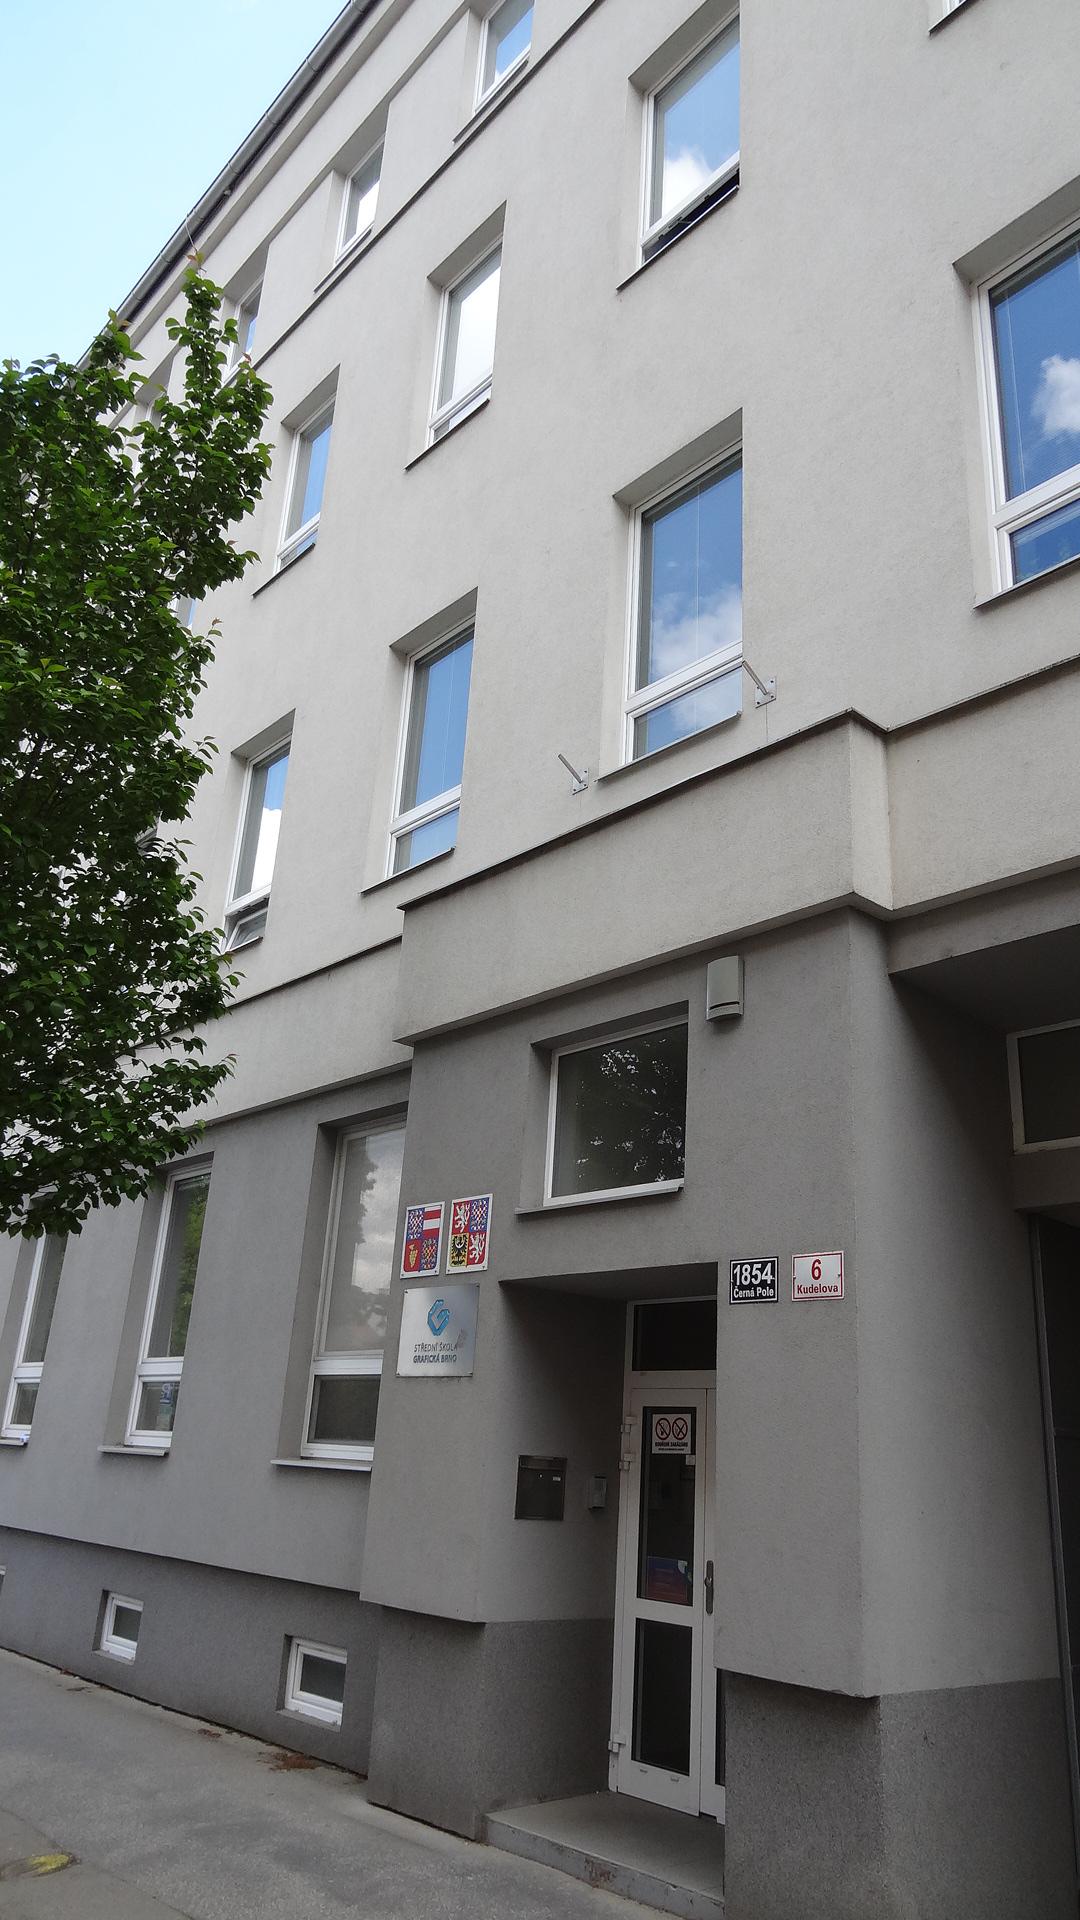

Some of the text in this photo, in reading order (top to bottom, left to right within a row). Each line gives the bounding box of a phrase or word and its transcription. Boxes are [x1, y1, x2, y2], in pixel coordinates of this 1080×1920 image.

[733, 1262, 773, 1285] 1854
[811, 1259, 821, 1280] 6
[733, 1285, 774, 1298] Černá Pole
[797, 1284, 838, 1294] Kudelova
[413, 1341, 457, 1352] STŘEDNÍ ŠKOLA
[413, 1353, 457, 1363] GRAFICKÁ BRNO
